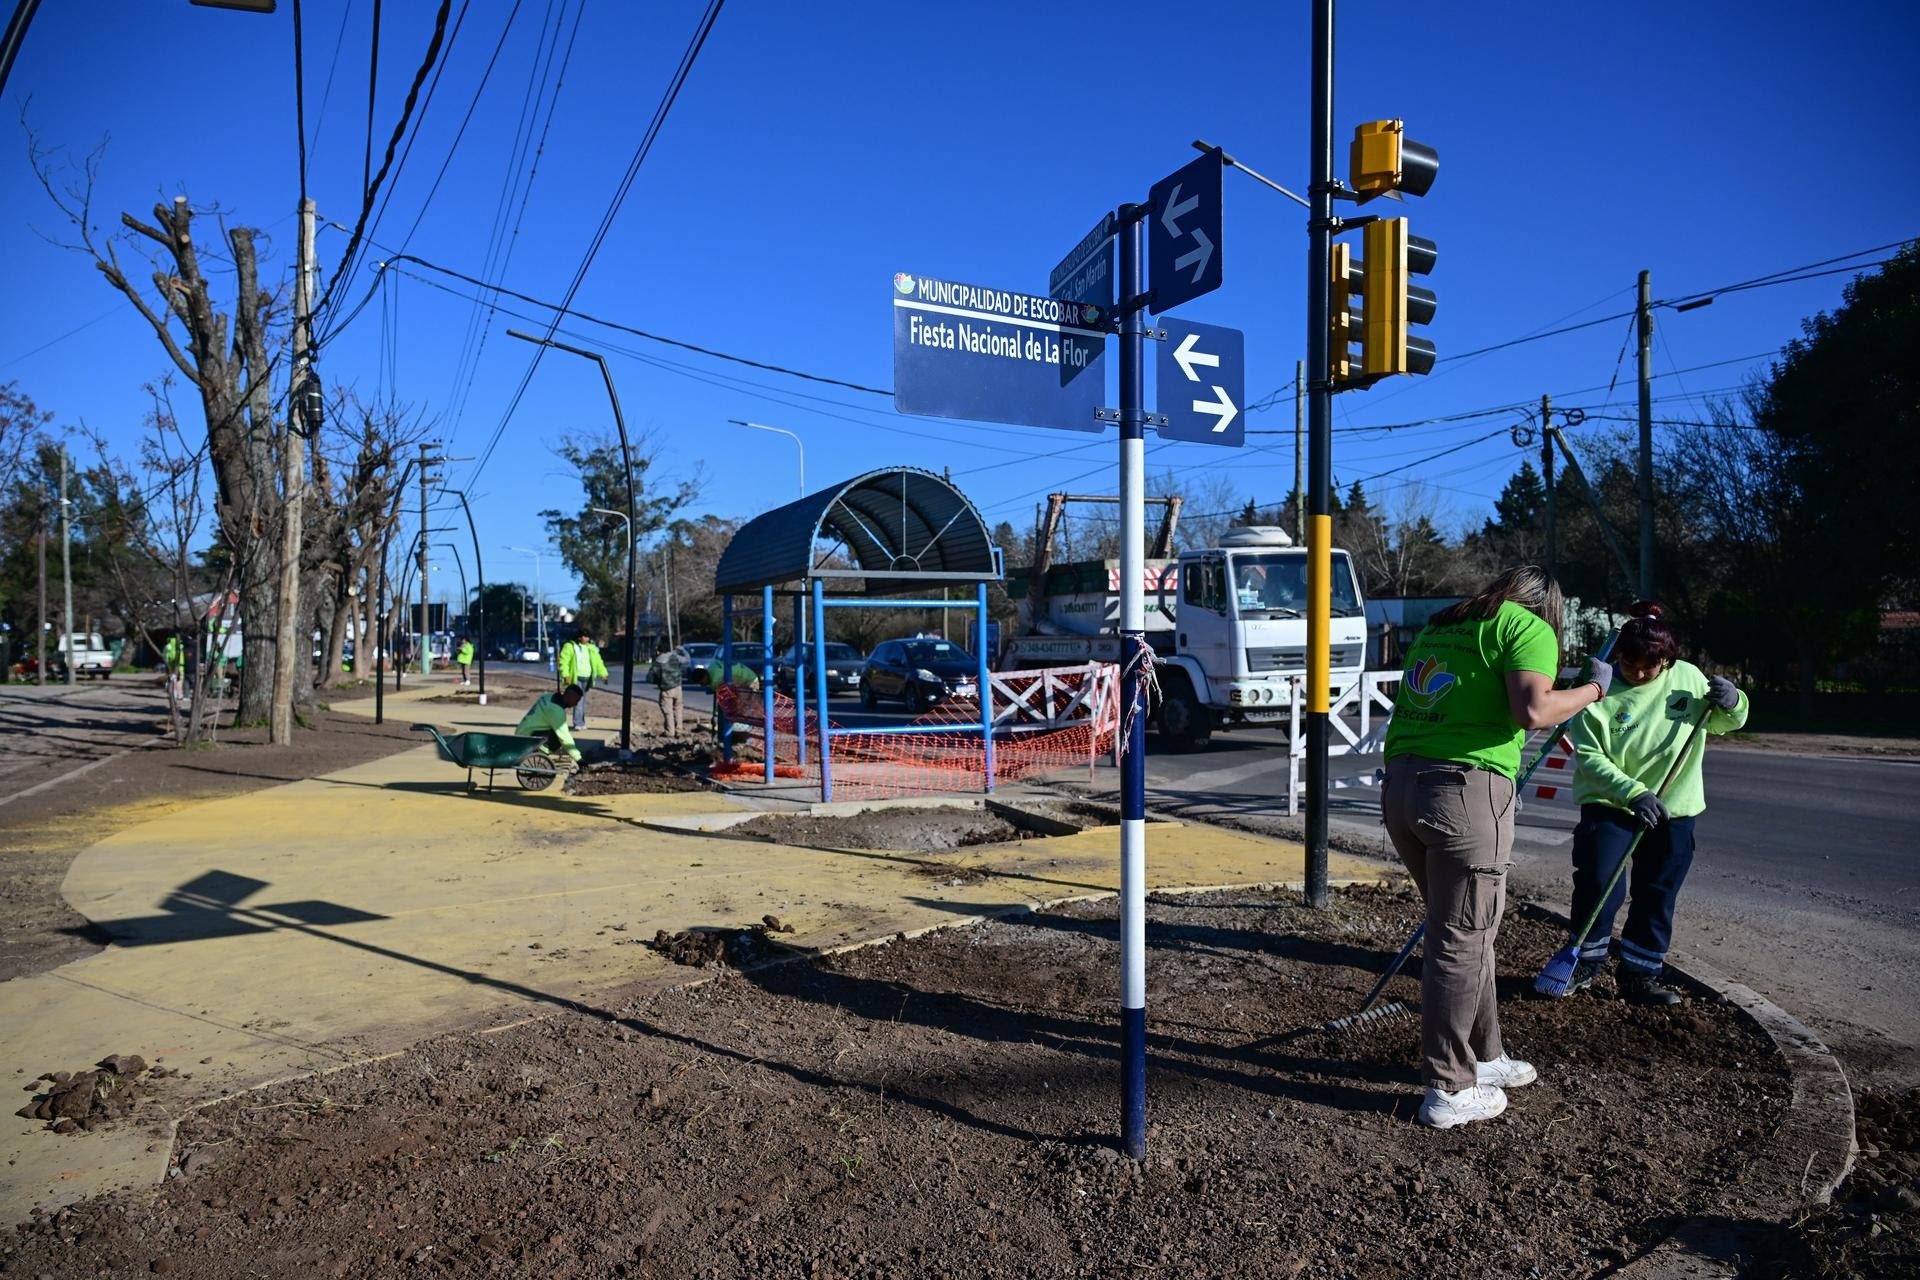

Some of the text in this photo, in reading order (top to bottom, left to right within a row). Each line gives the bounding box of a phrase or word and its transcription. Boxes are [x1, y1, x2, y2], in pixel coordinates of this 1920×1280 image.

[918, 278, 1080, 326] MUNICIPALIDAD DE ESCOBAR
[910, 315, 1089, 368] Fiesta Nacional de La Flor
